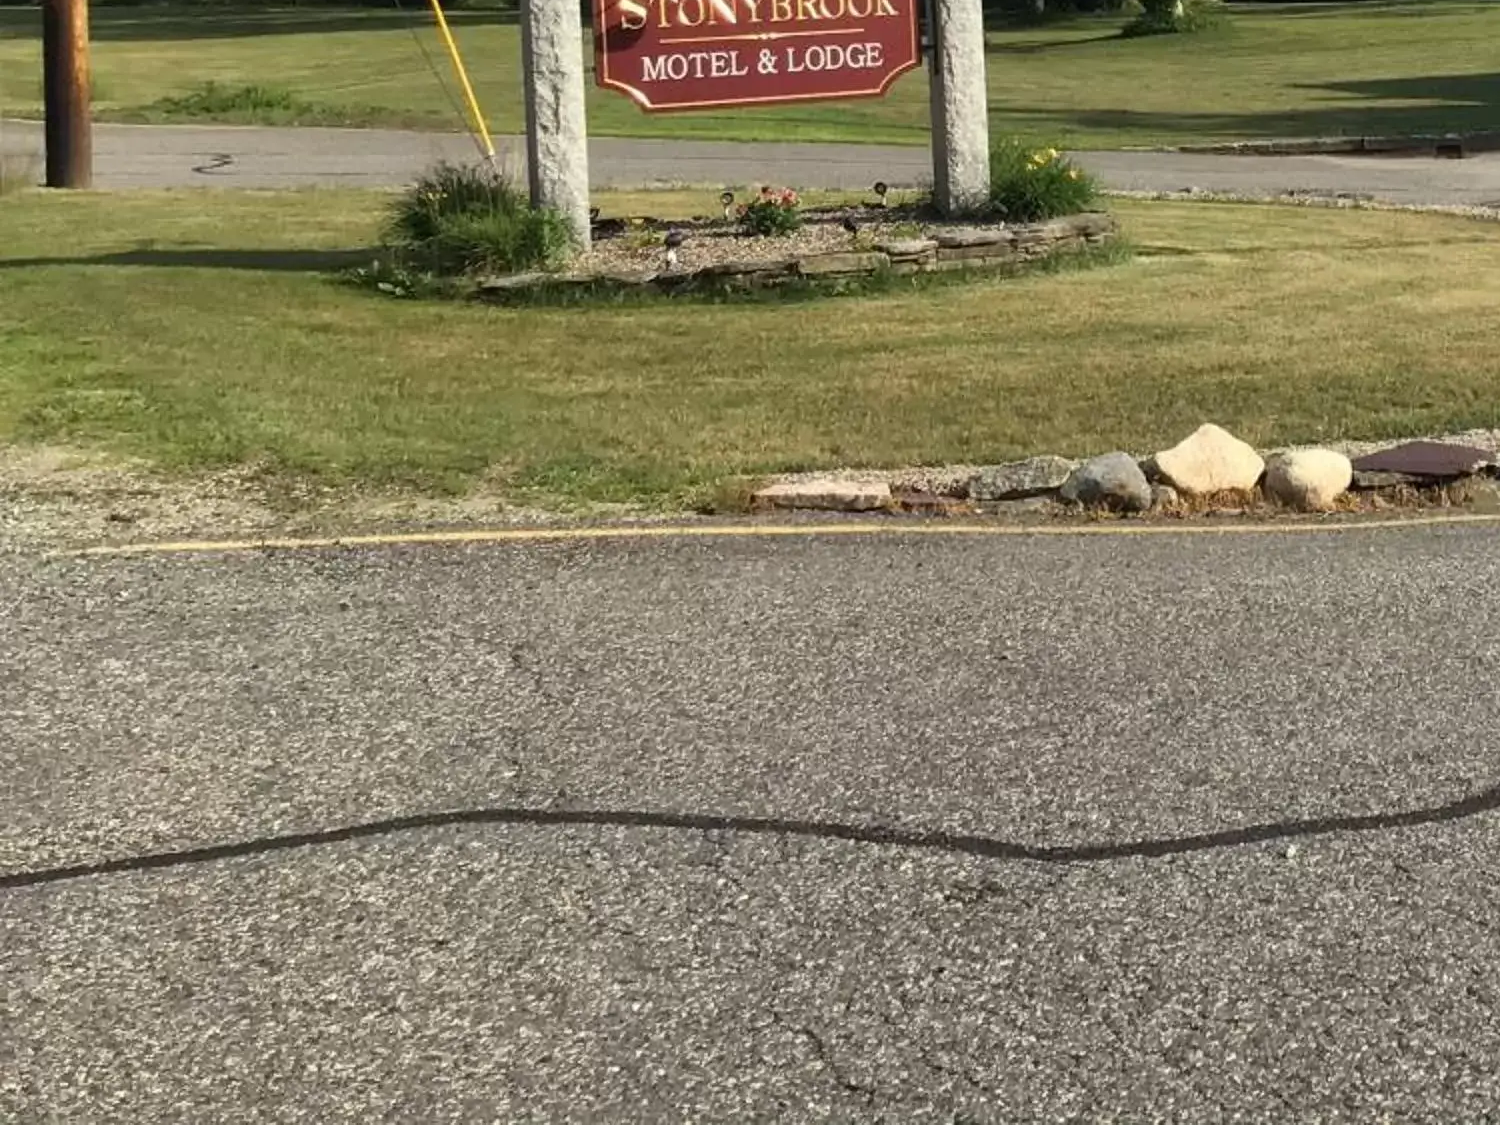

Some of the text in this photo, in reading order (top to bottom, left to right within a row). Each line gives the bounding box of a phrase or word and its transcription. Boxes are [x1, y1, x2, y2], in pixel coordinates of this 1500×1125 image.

[641, 43, 883, 82] MOTEL & LODGE
